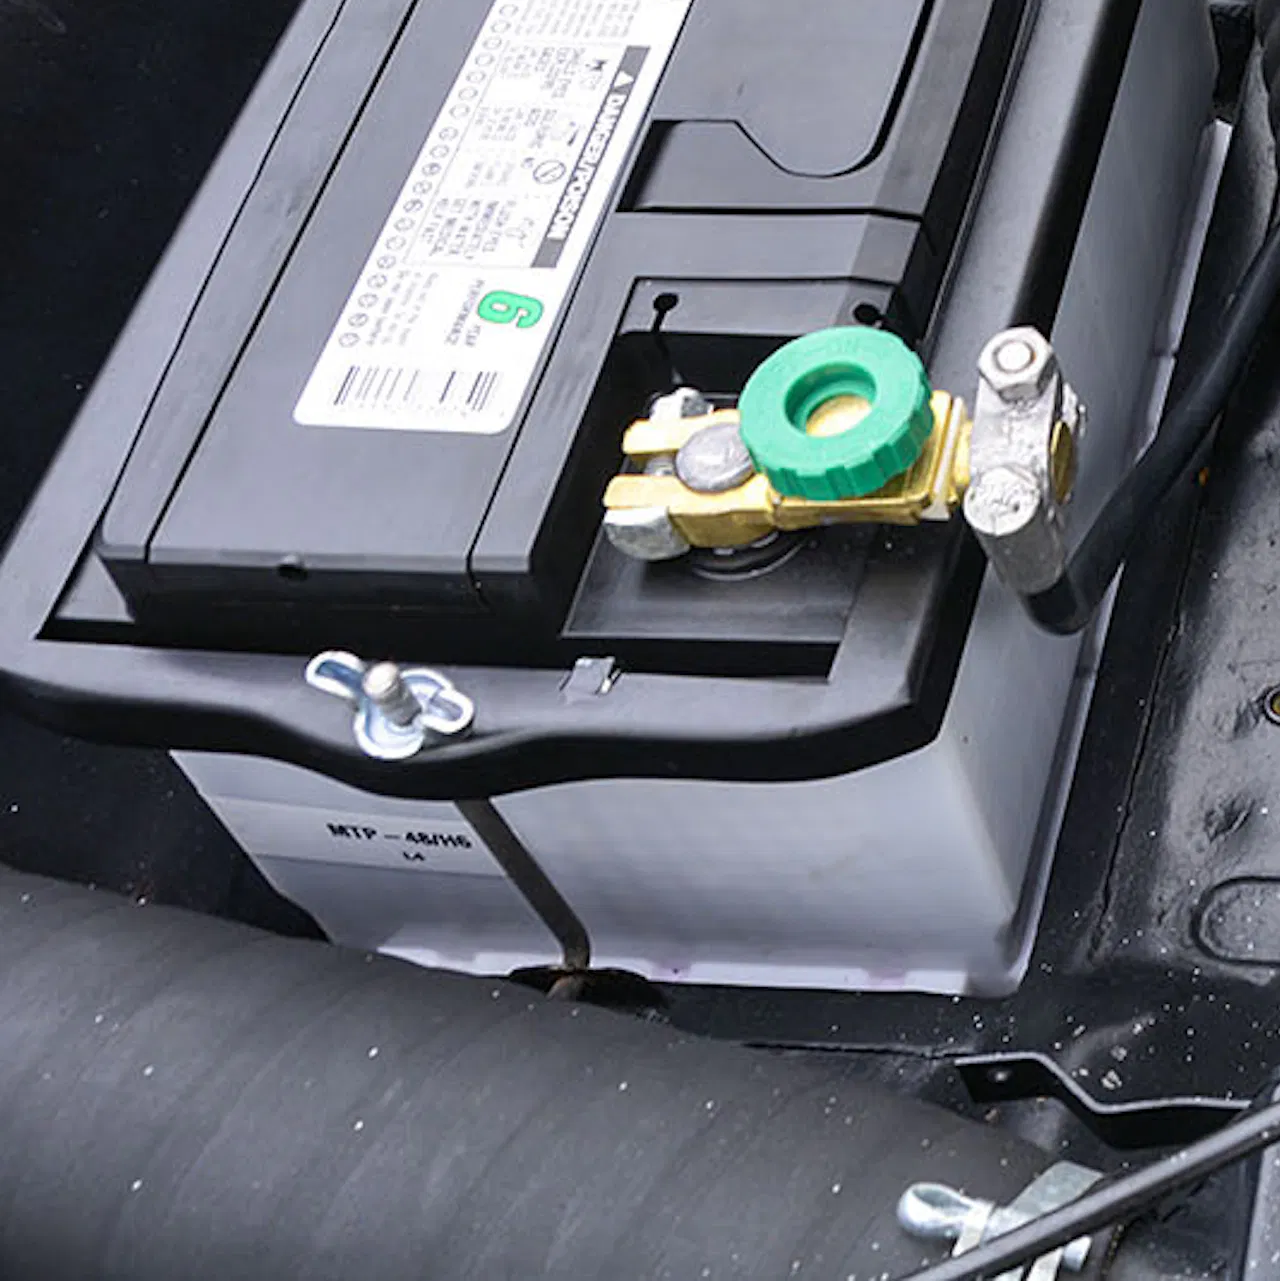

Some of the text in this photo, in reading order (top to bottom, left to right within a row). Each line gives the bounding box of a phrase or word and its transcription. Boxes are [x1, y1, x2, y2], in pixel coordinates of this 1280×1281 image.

[544, 93, 628, 239] DANGER/POISON
[477, 290, 545, 329] 6
[325, 822, 377, 841] MTP
